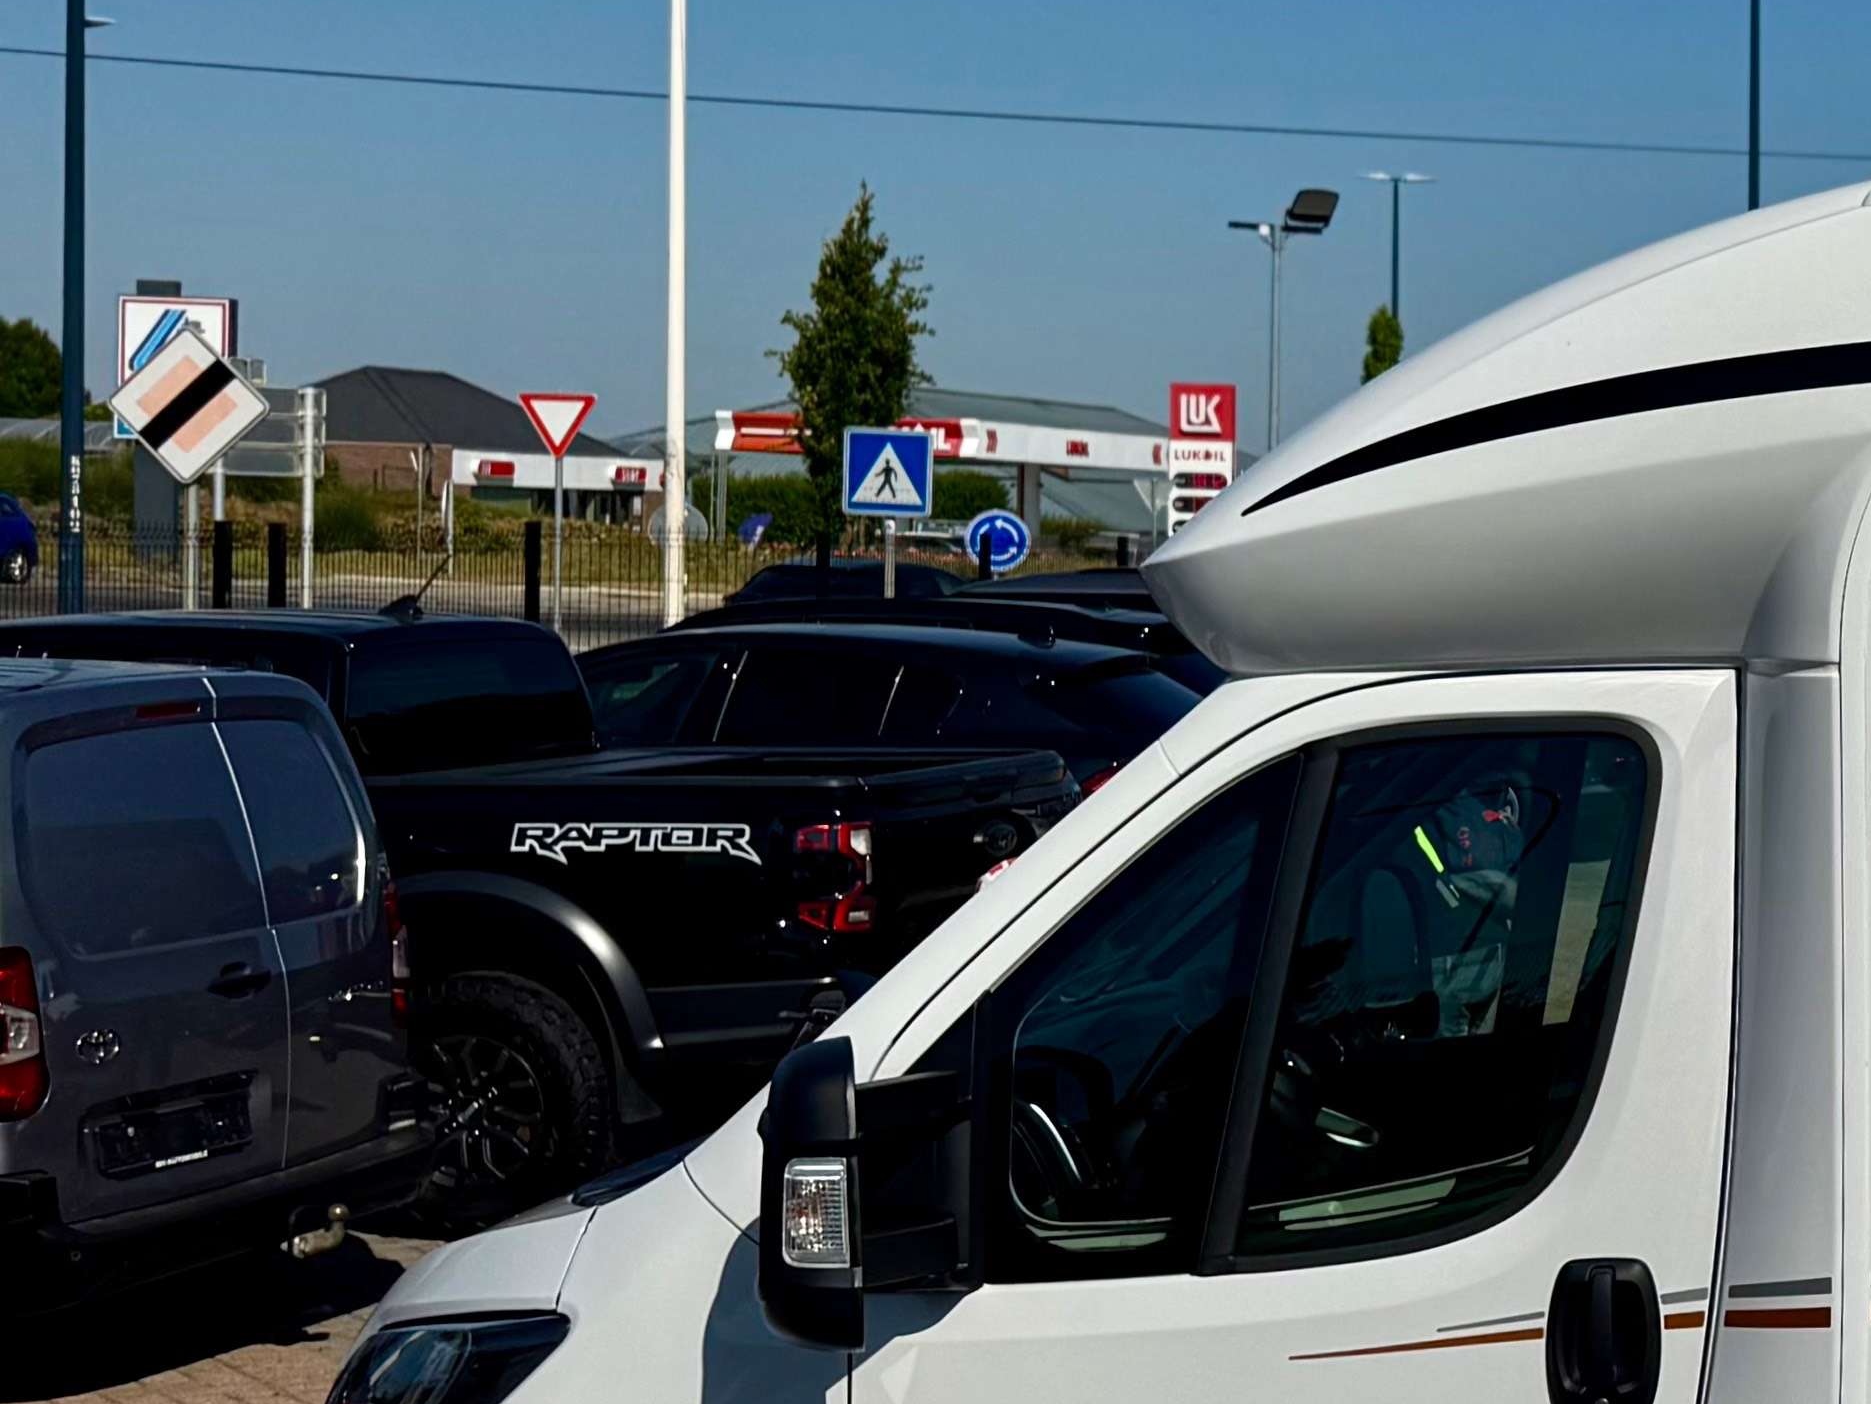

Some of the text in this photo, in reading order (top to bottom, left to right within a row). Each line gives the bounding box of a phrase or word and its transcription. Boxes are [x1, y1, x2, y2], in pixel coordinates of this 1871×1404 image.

[1180, 393, 1222, 434] LUK
[1174, 449, 1226, 462] LUKOIL
[510, 823, 762, 865] RAPTOR
